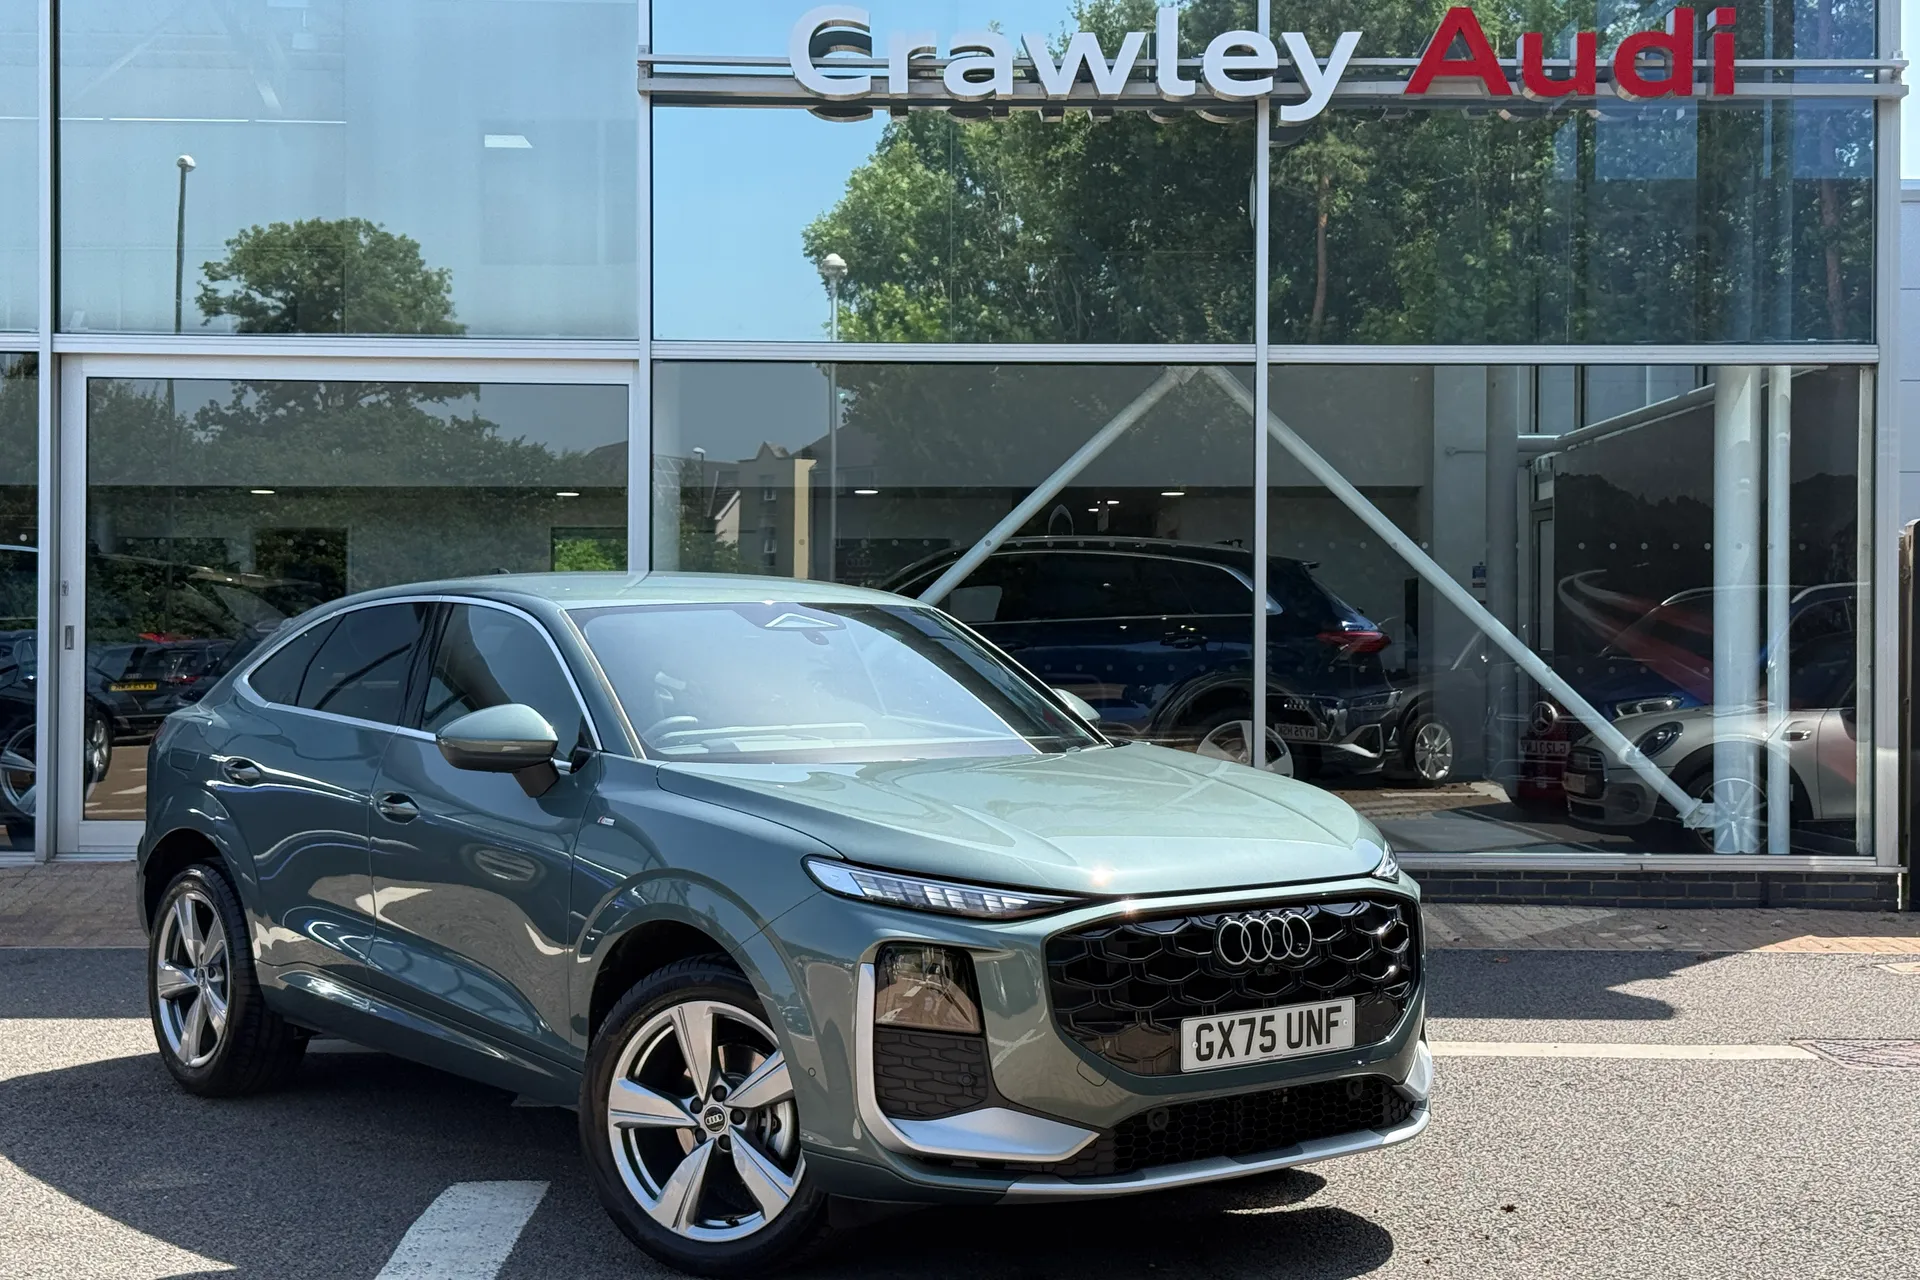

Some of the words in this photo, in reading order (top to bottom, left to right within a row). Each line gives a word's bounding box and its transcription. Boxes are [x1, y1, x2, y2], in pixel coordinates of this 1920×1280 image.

[789, 4, 1363, 121] Crawley
[1403, 6, 1735, 98] Audi
[1195, 1015, 1277, 1061] GX75
[1286, 1006, 1342, 1049] UNF
